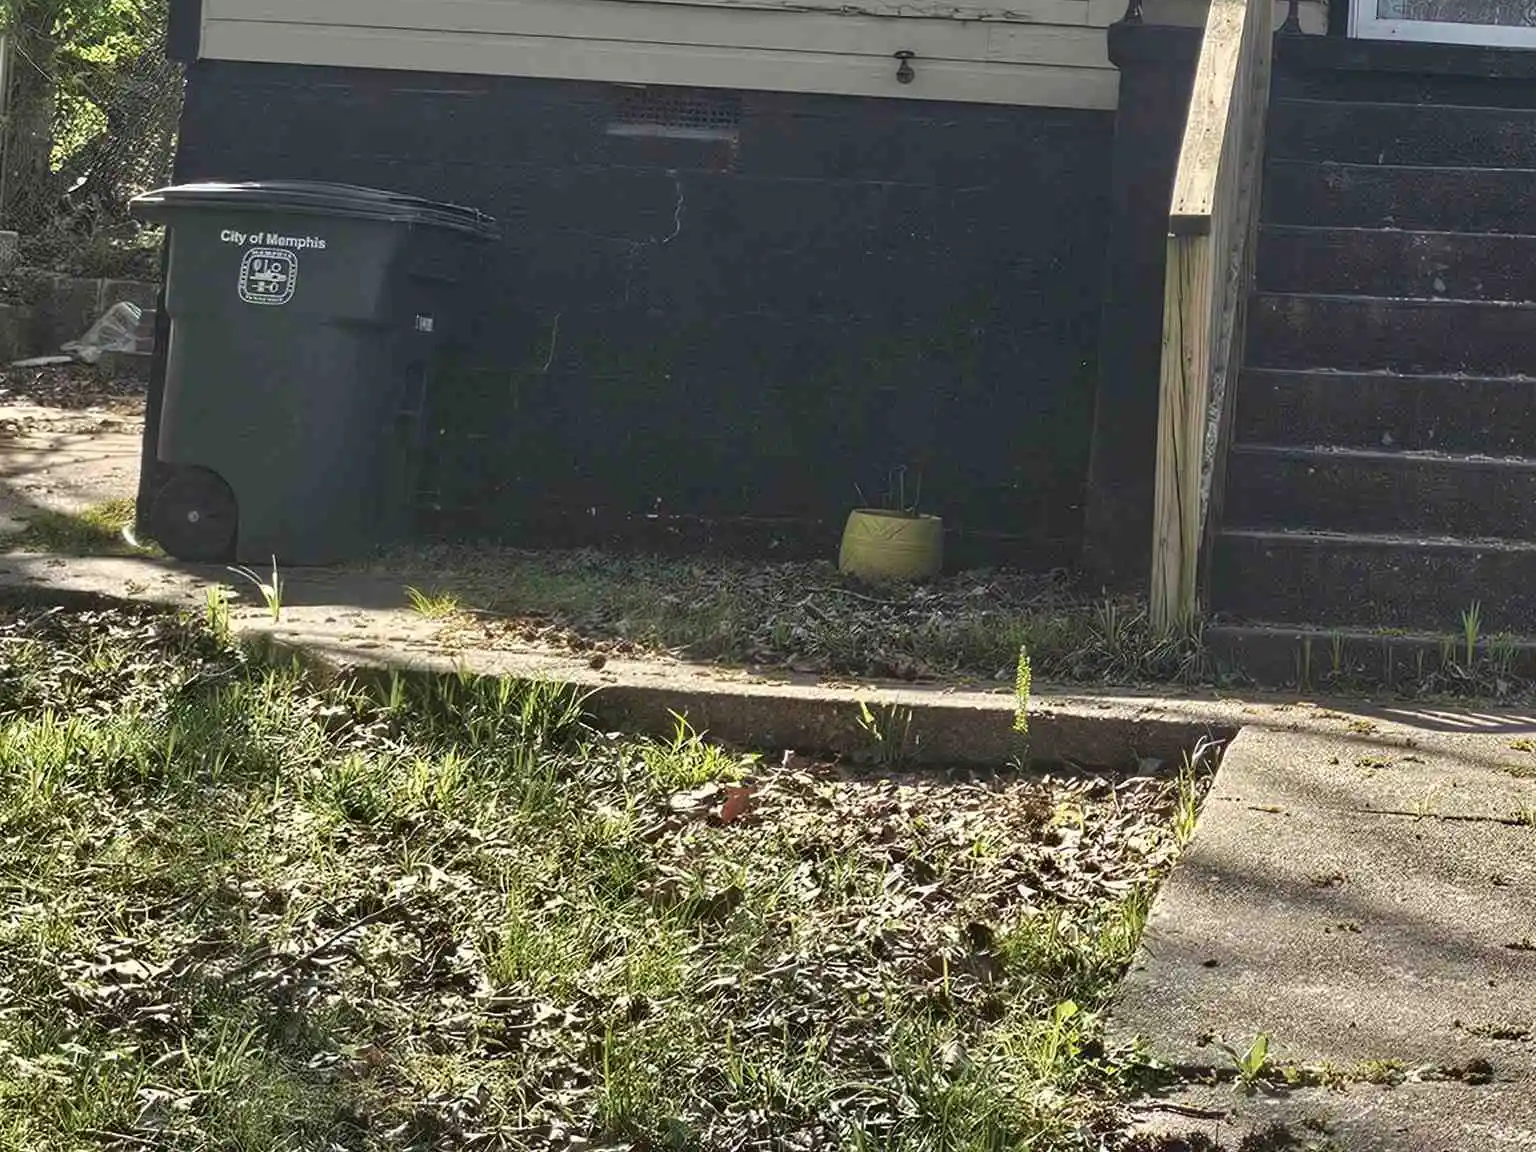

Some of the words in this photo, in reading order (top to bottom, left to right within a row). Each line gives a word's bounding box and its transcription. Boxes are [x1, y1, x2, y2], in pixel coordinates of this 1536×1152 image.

[221, 229, 246, 246] City
[249, 232, 264, 244] of
[266, 233, 326, 250] Memphis
